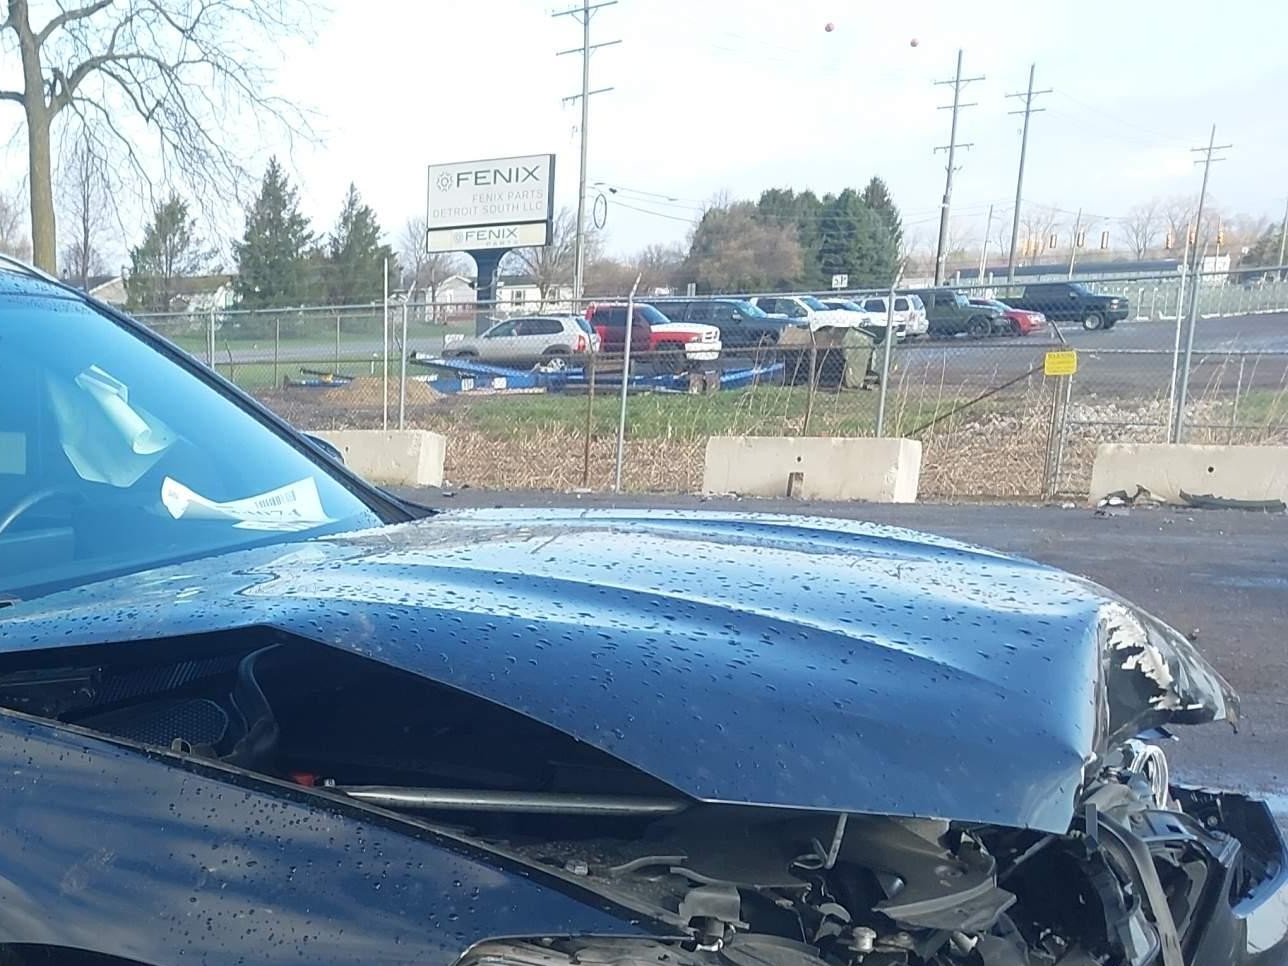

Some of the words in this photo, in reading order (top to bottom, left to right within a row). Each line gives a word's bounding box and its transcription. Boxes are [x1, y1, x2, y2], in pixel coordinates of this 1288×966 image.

[457, 165, 540, 188] FENIX
[472, 192, 504, 203] FENIX
[507, 190, 543, 201] PARTS
[432, 207, 478, 218] DETROIT
[482, 204, 519, 215] SOUTH
[523, 201, 543, 211] LLC
[465, 227, 518, 241] FENIX
